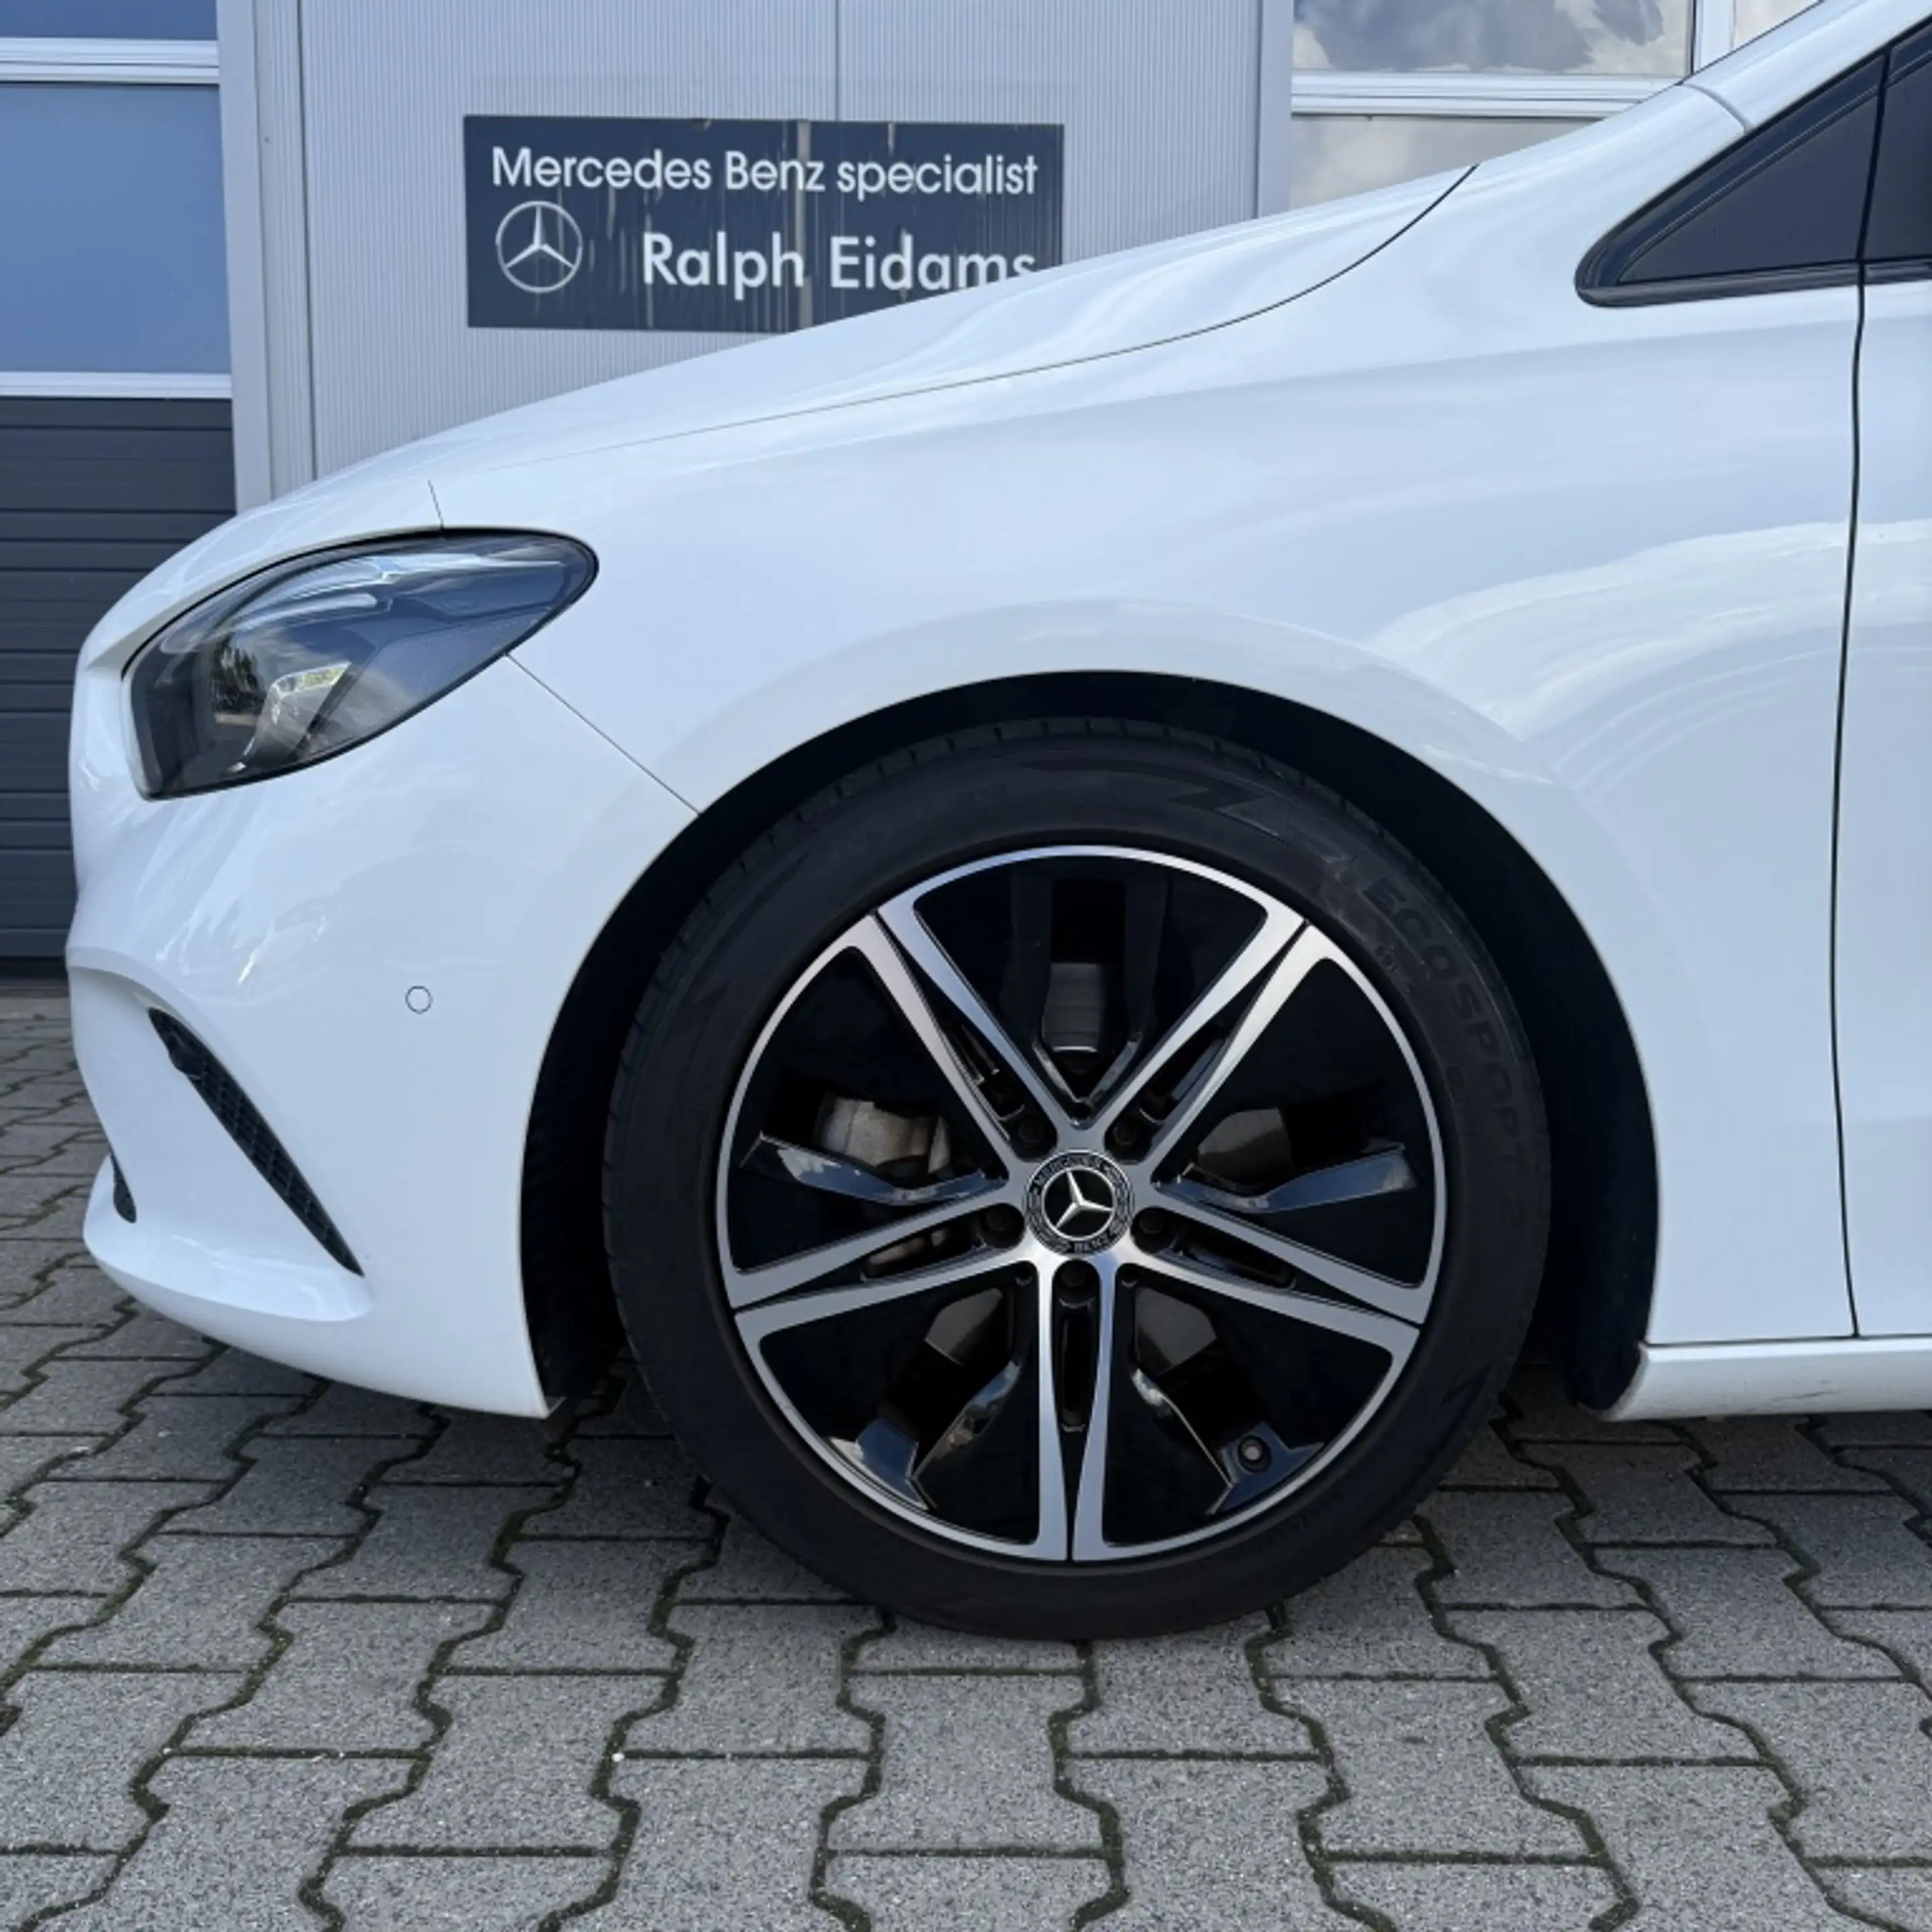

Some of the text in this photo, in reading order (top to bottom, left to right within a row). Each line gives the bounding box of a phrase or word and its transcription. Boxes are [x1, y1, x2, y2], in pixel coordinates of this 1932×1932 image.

[492, 146, 1038, 202] Mercedes Benz specialist
[642, 231, 804, 301] Ralph
